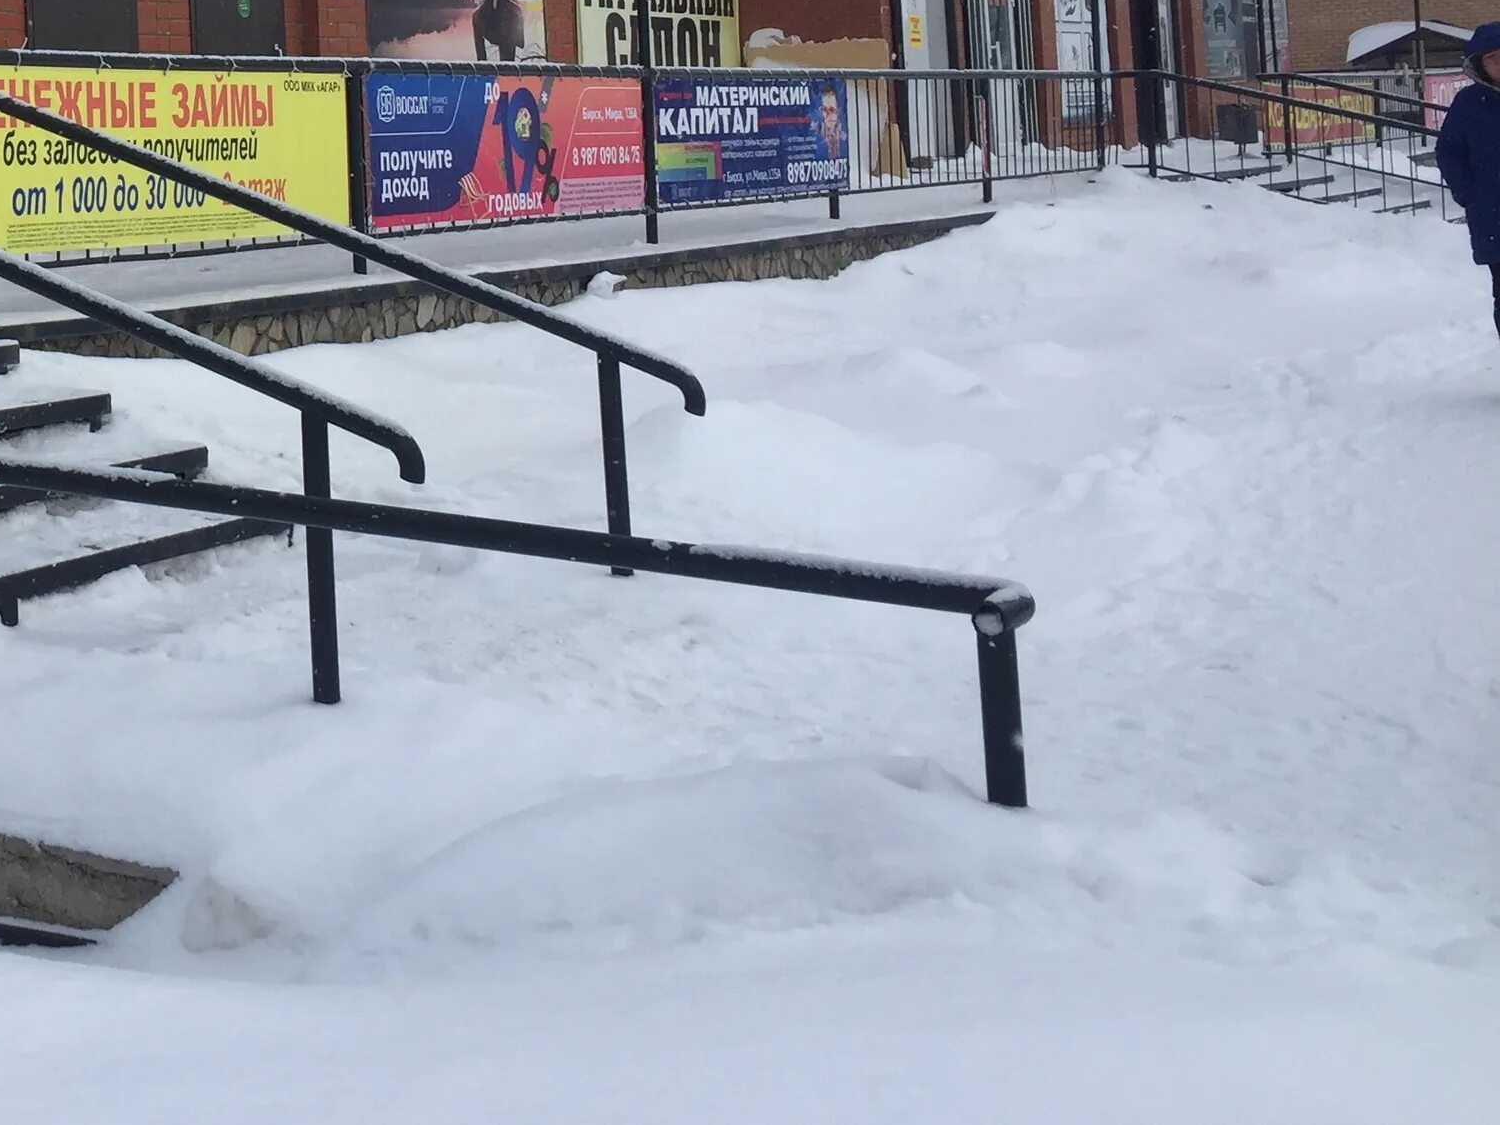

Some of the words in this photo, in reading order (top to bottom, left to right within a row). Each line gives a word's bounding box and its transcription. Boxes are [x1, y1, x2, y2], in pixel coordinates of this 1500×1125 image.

[172, 75, 274, 127] ЗАЙМЫ
[284, 80, 300, 92] ООО
[301, 81, 315, 92] МКК
[484, 82, 500, 103] до
[696, 82, 810, 106] МАТЕРИНСКИЙ
[396, 96, 428, 115] BOGGAT
[582, 106, 604, 122] Бирск,
[605, 106, 624, 121] Мира,
[659, 107, 759, 136] КАПИТАЛ
[3, 130, 37, 165] без
[572, 148, 579, 166] 8
[581, 147, 597, 165] 987
[600, 147, 617, 164] 090
[618, 146, 630, 163] 84
[380, 149, 452, 176] получите
[13, 185, 46, 216] от
[72, 175, 107, 213] 000
[113, 174, 138, 211] до
[145, 175, 167, 210] 30
[381, 176, 429, 203] доход
[489, 191, 544, 215] годовых
